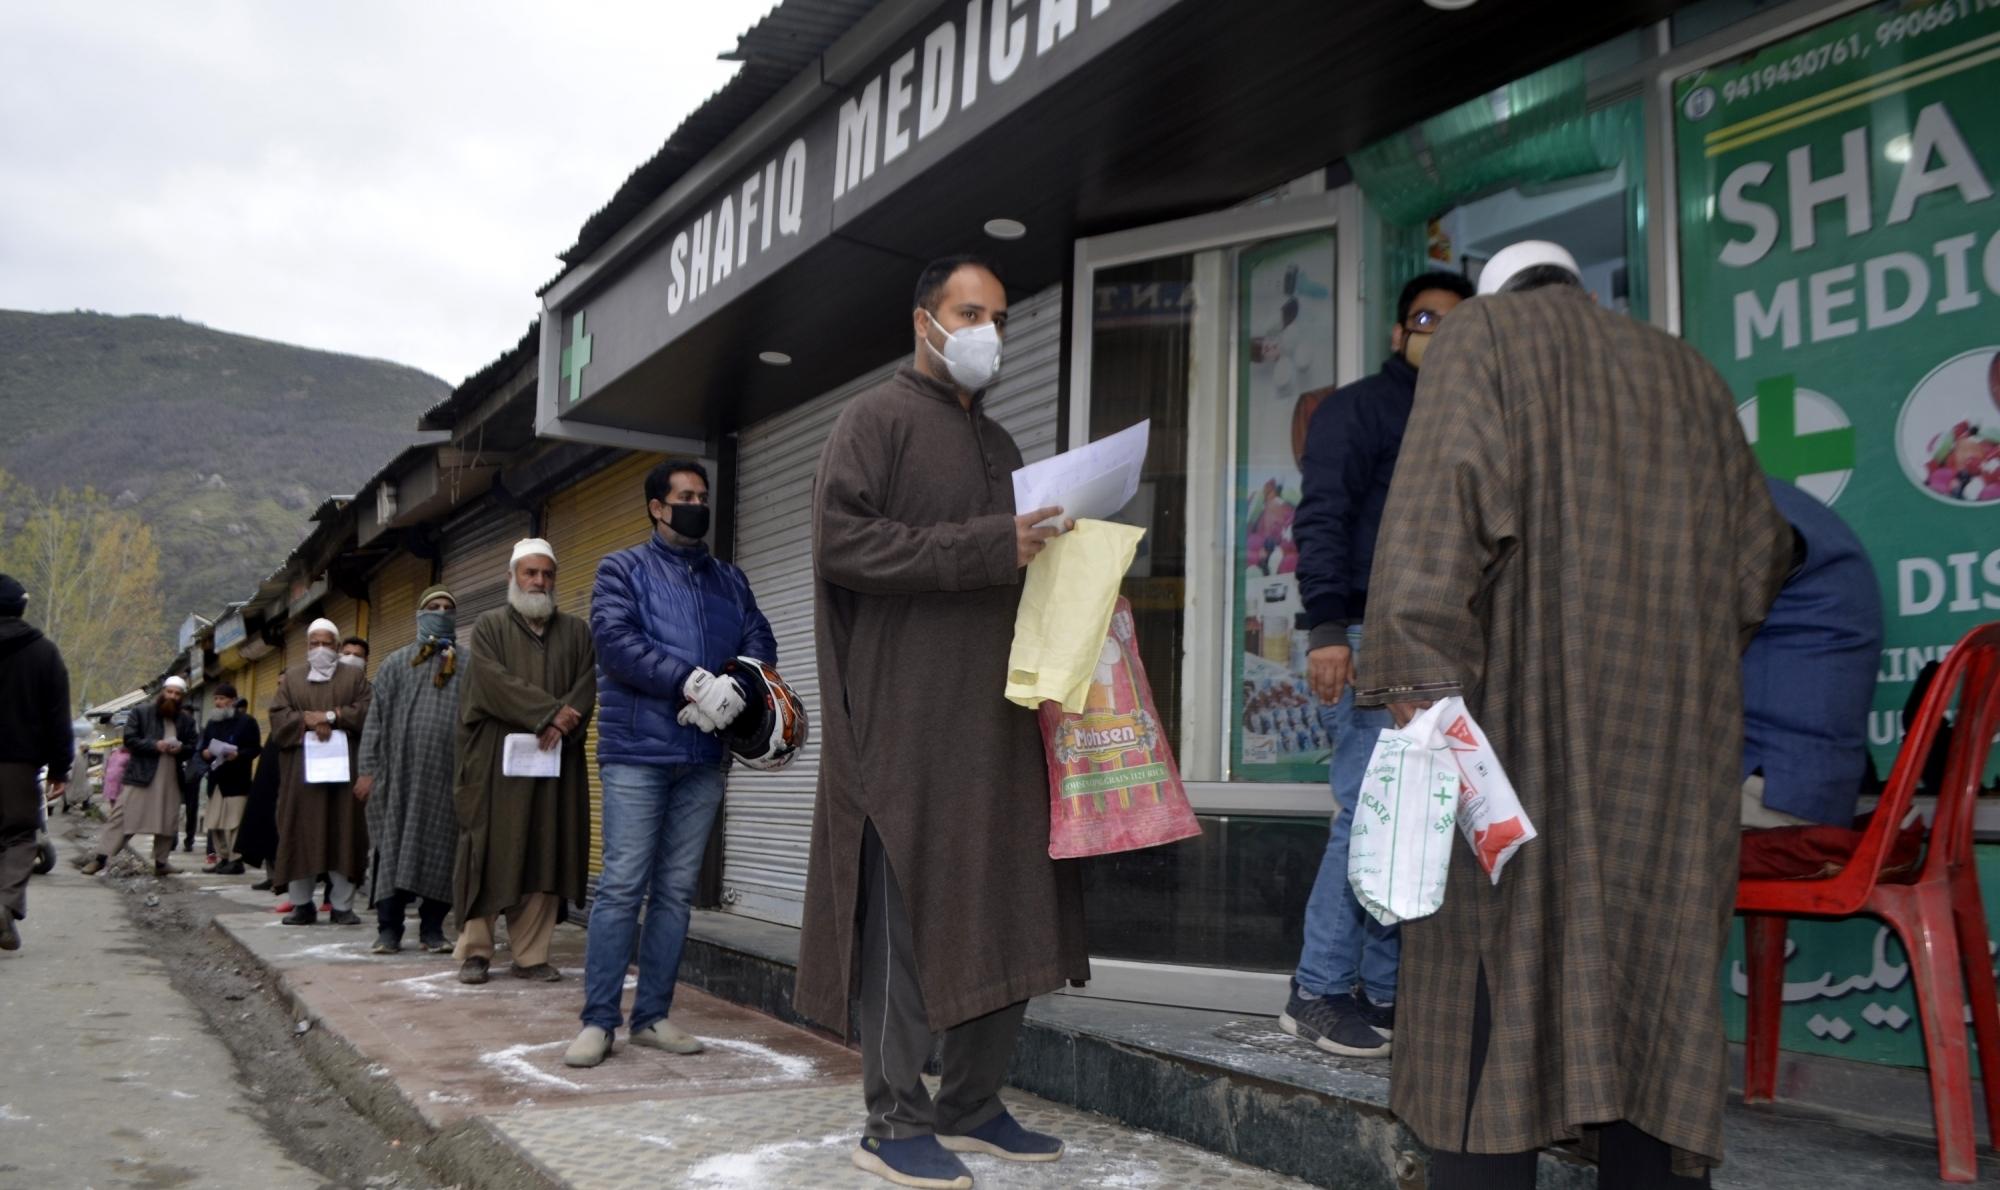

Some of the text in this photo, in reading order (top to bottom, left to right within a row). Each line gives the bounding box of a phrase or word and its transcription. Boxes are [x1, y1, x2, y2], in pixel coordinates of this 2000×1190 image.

[667, 0, 1111, 317] SHAFIQ MEDICA
[1734, 229, 2000, 360] MEDI
[1074, 726, 1136, 748] Mohsen
